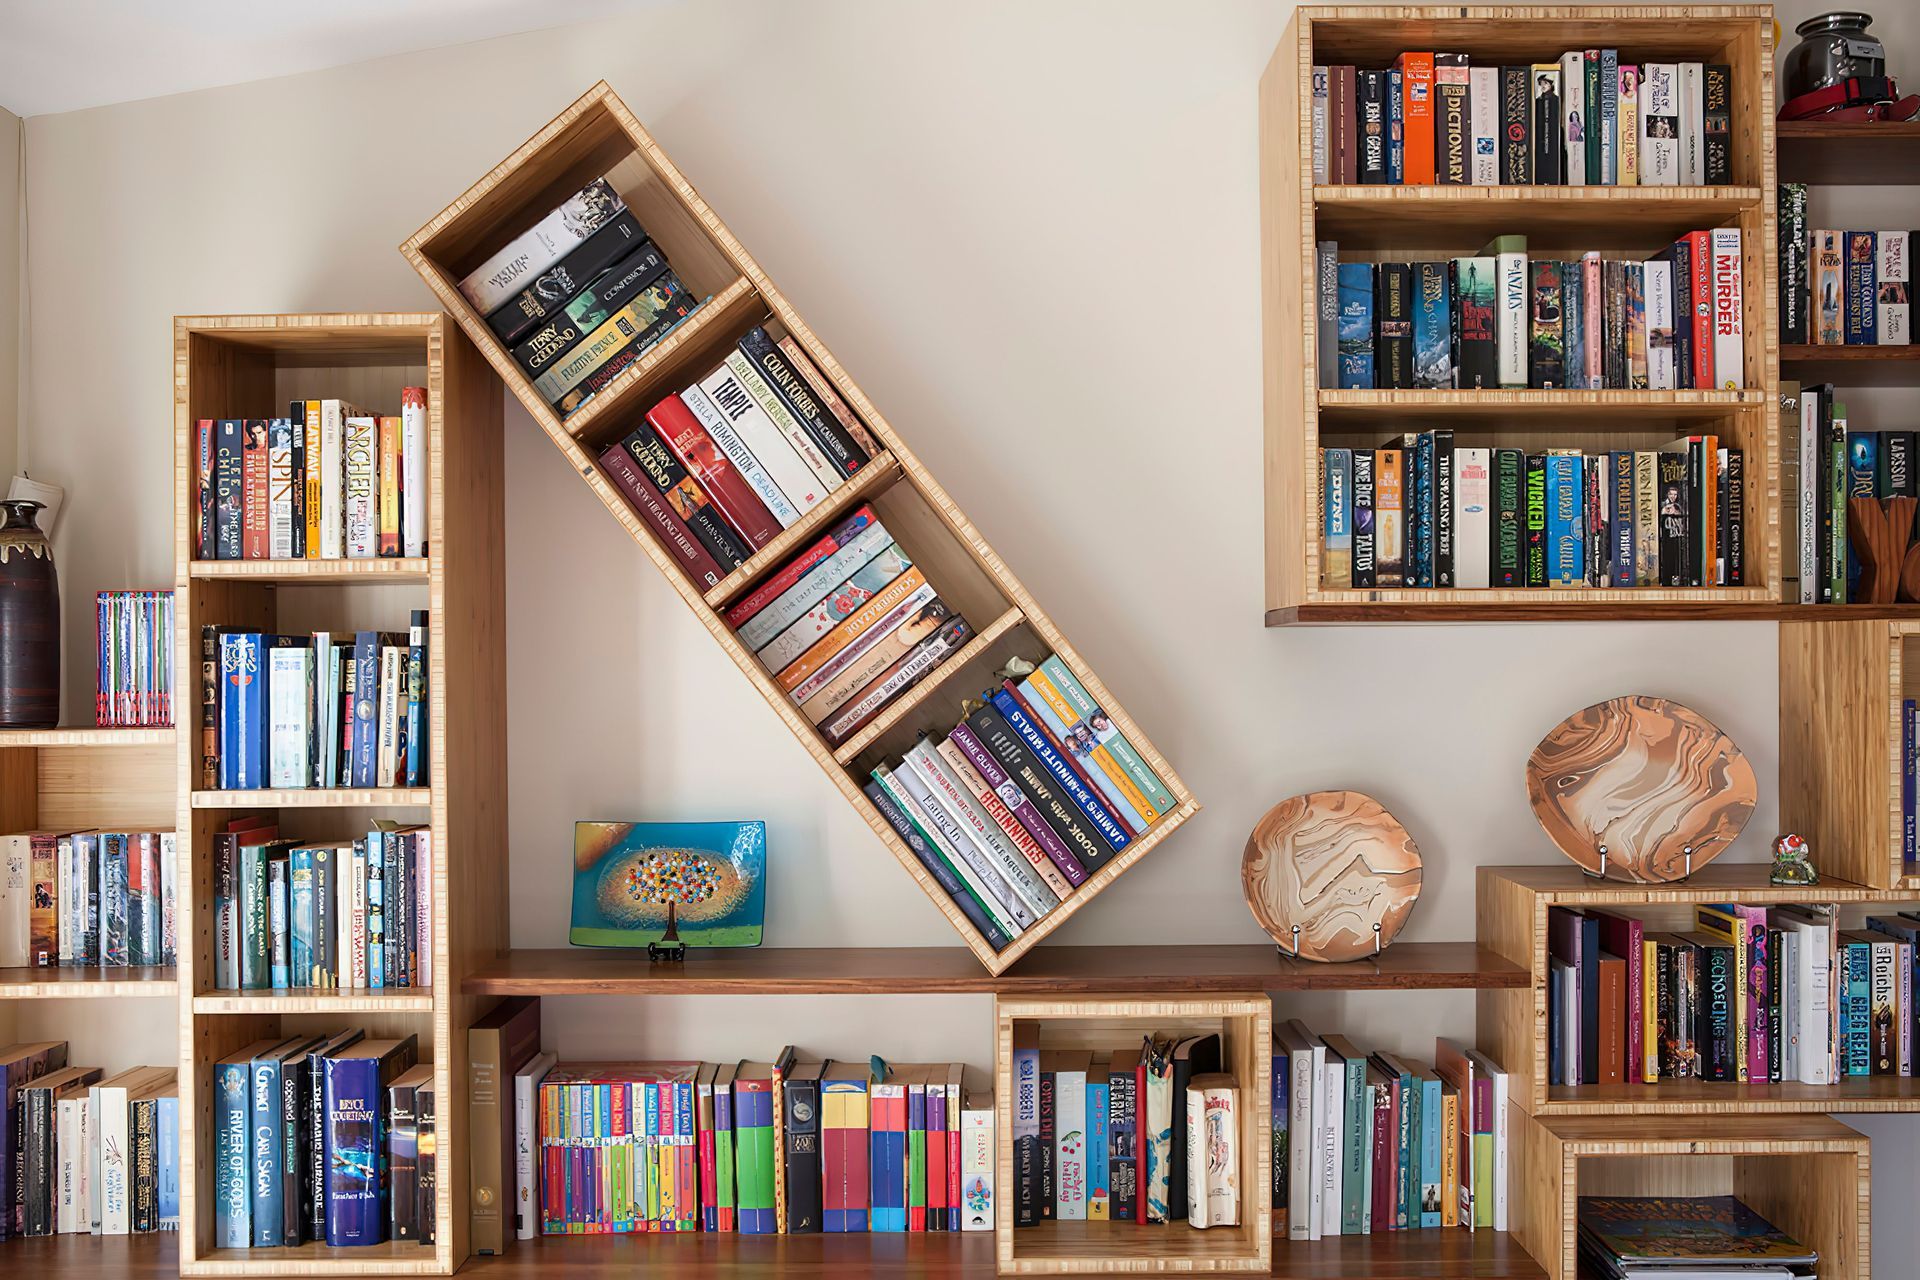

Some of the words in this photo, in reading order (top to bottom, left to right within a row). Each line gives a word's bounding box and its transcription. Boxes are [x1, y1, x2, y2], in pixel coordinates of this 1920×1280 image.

[1603, 56, 1615, 118] SURVIVOR
[1447, 98, 1463, 182] DICTIONARY
[1794, 194, 1802, 212] THE
[1794, 217, 1802, 247] SLAP
[1507, 270, 1522, 309] ANZACS
[1717, 255, 1732, 335] MURDER
[710, 376, 754, 422] TEMPLE
[734, 361, 768, 400] BELLAMY
[761, 351, 793, 387] COLIN
[784, 380, 820, 420] FORBES
[307, 410, 319, 480] HEATWAVE
[687, 392, 714, 423] STELLA
[709, 420, 755, 473] RIMINGTON
[219, 448, 228, 496] CHILD
[231, 457, 240, 486] LEE
[272, 451, 291, 501] SPIN
[348, 423, 370, 499] ARCHER
[619, 466, 637, 485] THE
[1355, 455, 1372, 482] ANNE
[1440, 455, 1449, 476] THE
[1500, 452, 1516, 474] CLIVE
[1559, 458, 1573, 482] CLIVE
[1618, 455, 1631, 475] KEN
[1730, 454, 1741, 476] KEN
[1891, 438, 1906, 488] LARSSON
[1332, 475, 1343, 533] DUNE
[1355, 483, 1372, 506] RICE
[1500, 476, 1516, 511] BARKER
[1528, 469, 1544, 530] WICKED
[1618, 478, 1630, 522] FOLLETT
[1730, 479, 1740, 521] FOLLETT
[1356, 534, 1372, 571] TALTOS
[1500, 519, 1516, 568] SACRAMENT
[1620, 528, 1630, 566] TRIPLE
[1009, 710, 1045, 750] MEALS
[954, 728, 979, 756] JAMIE
[975, 753, 1003, 784] OLIVER
[1039, 746, 1090, 803] 30-MINUTE
[1019, 765, 1052, 802] JAMIE
[919, 794, 954, 832] Eating
[948, 825, 964, 842] In
[978, 789, 1046, 865] BEGINNINGS
[1048, 798, 1073, 826] with
[1085, 800, 1125, 846] JAMIE'S
[1067, 822, 1099, 857] COOK
[1876, 956, 1892, 1001] Reichs
[1851, 997, 1868, 1028] GREG
[1020, 1059, 1033, 1081] NORA
[1851, 1033, 1868, 1067] BEAR
[1020, 1084, 1033, 1120] ROBERTS
[1041, 1080, 1053, 1114] OPUS
[1110, 1077, 1125, 1125] CLARKE
[231, 1110, 243, 1153] RIVER
[257, 1126, 272, 1157] CARL
[231, 1156, 243, 1176] OF
[257, 1160, 272, 1197] SAGAN
[1326, 1127, 1334, 1191] BITTERSWEET
[231, 1178, 243, 1218] GODS
[1059, 1161, 1072, 1203] holiday
